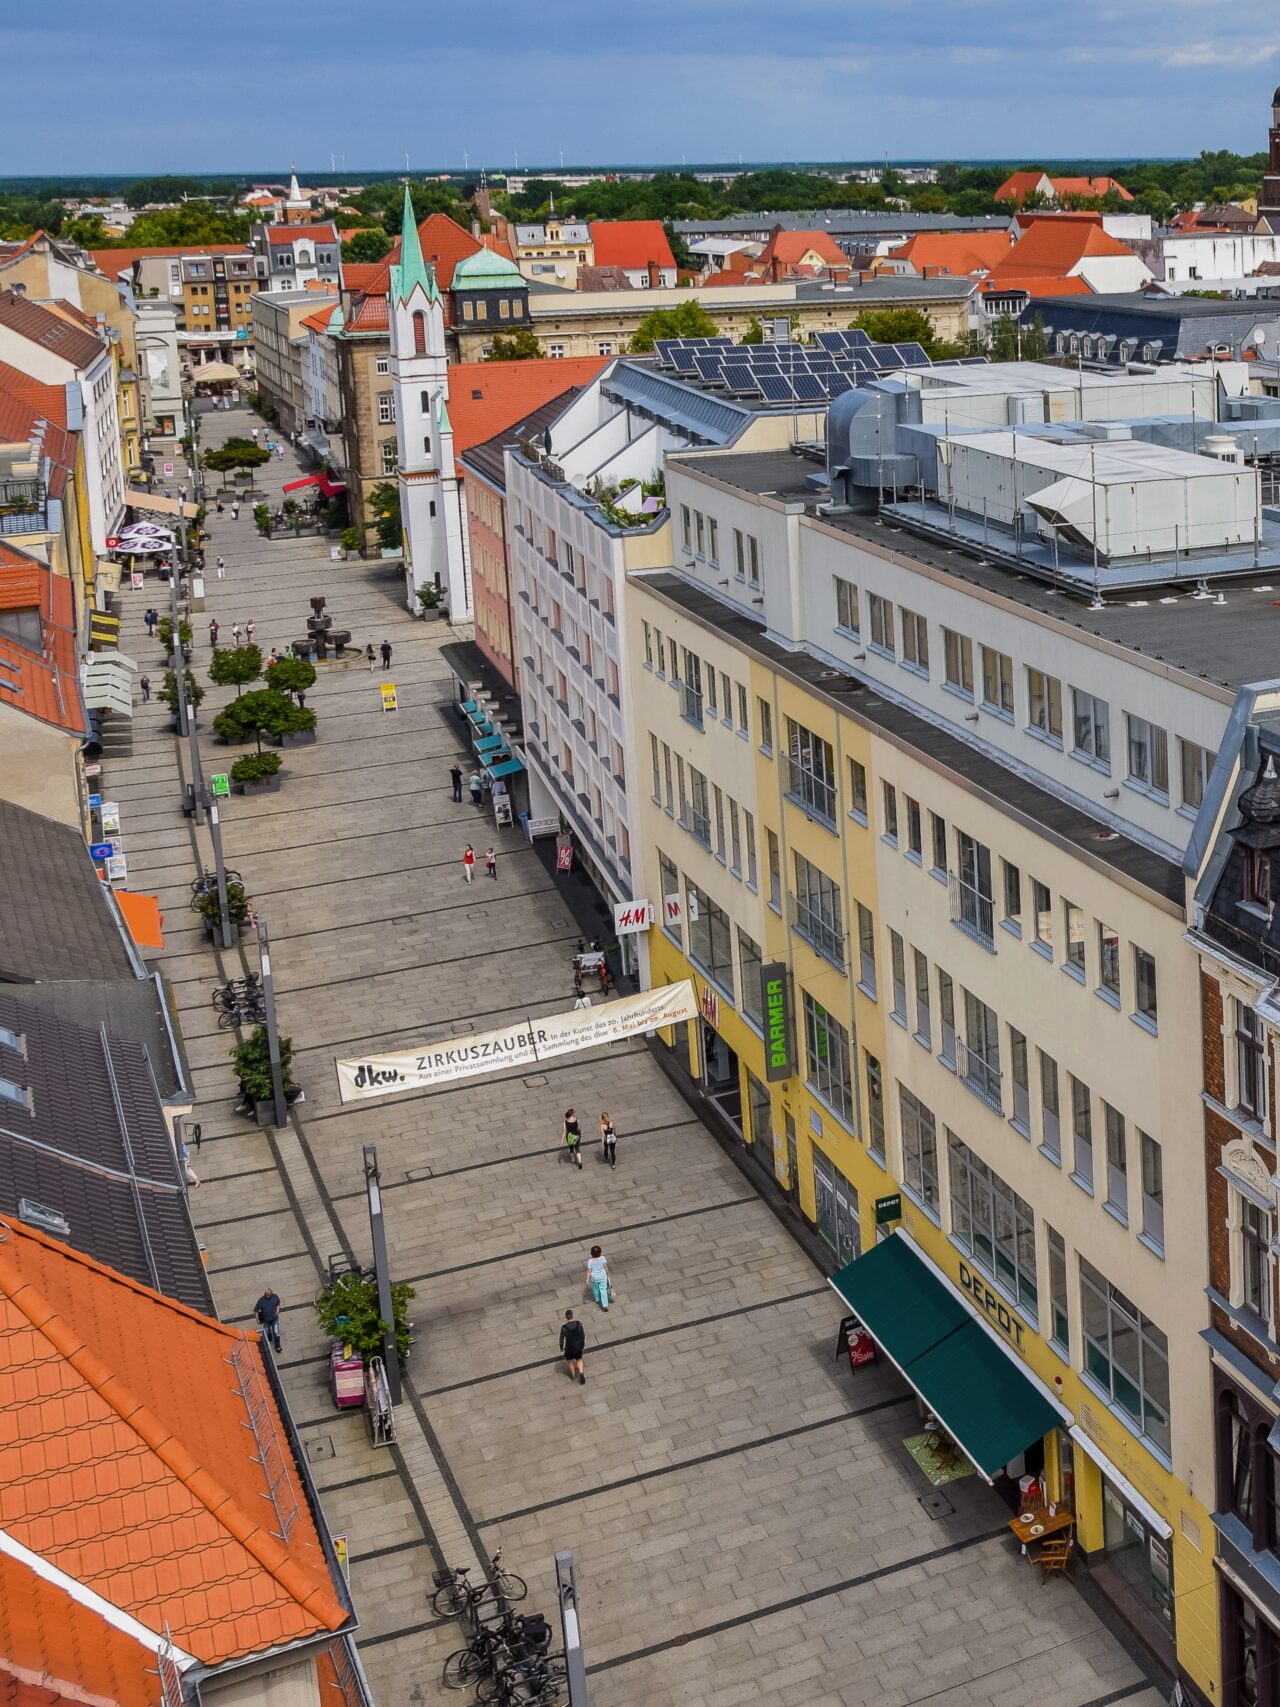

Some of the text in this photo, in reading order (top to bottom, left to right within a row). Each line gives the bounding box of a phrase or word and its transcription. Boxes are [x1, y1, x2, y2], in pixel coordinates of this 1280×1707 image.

[618, 907, 646, 928] H&M
[416, 1030, 548, 1070] ZIRKUSZAUBER
[560, 1030, 571, 1038] der
[573, 1025, 593, 1034] Kunst
[595, 1021, 606, 1029] des
[434, 1068, 452, 1077] einer
[455, 1054, 513, 1072] Privatsammlung
[514, 1049, 528, 1059] und
[530, 1047, 541, 1055] dr
[543, 1038, 580, 1051] Sammlung
[581, 1034, 592, 1042] des
[622, 1022, 636, 1031] Mai
[663, 1007, 688, 1018] August
[767, 979, 787, 1068] BARMER
[878, 1198, 899, 1209] DEPOT
[959, 1261, 1024, 1344] DEPOT
